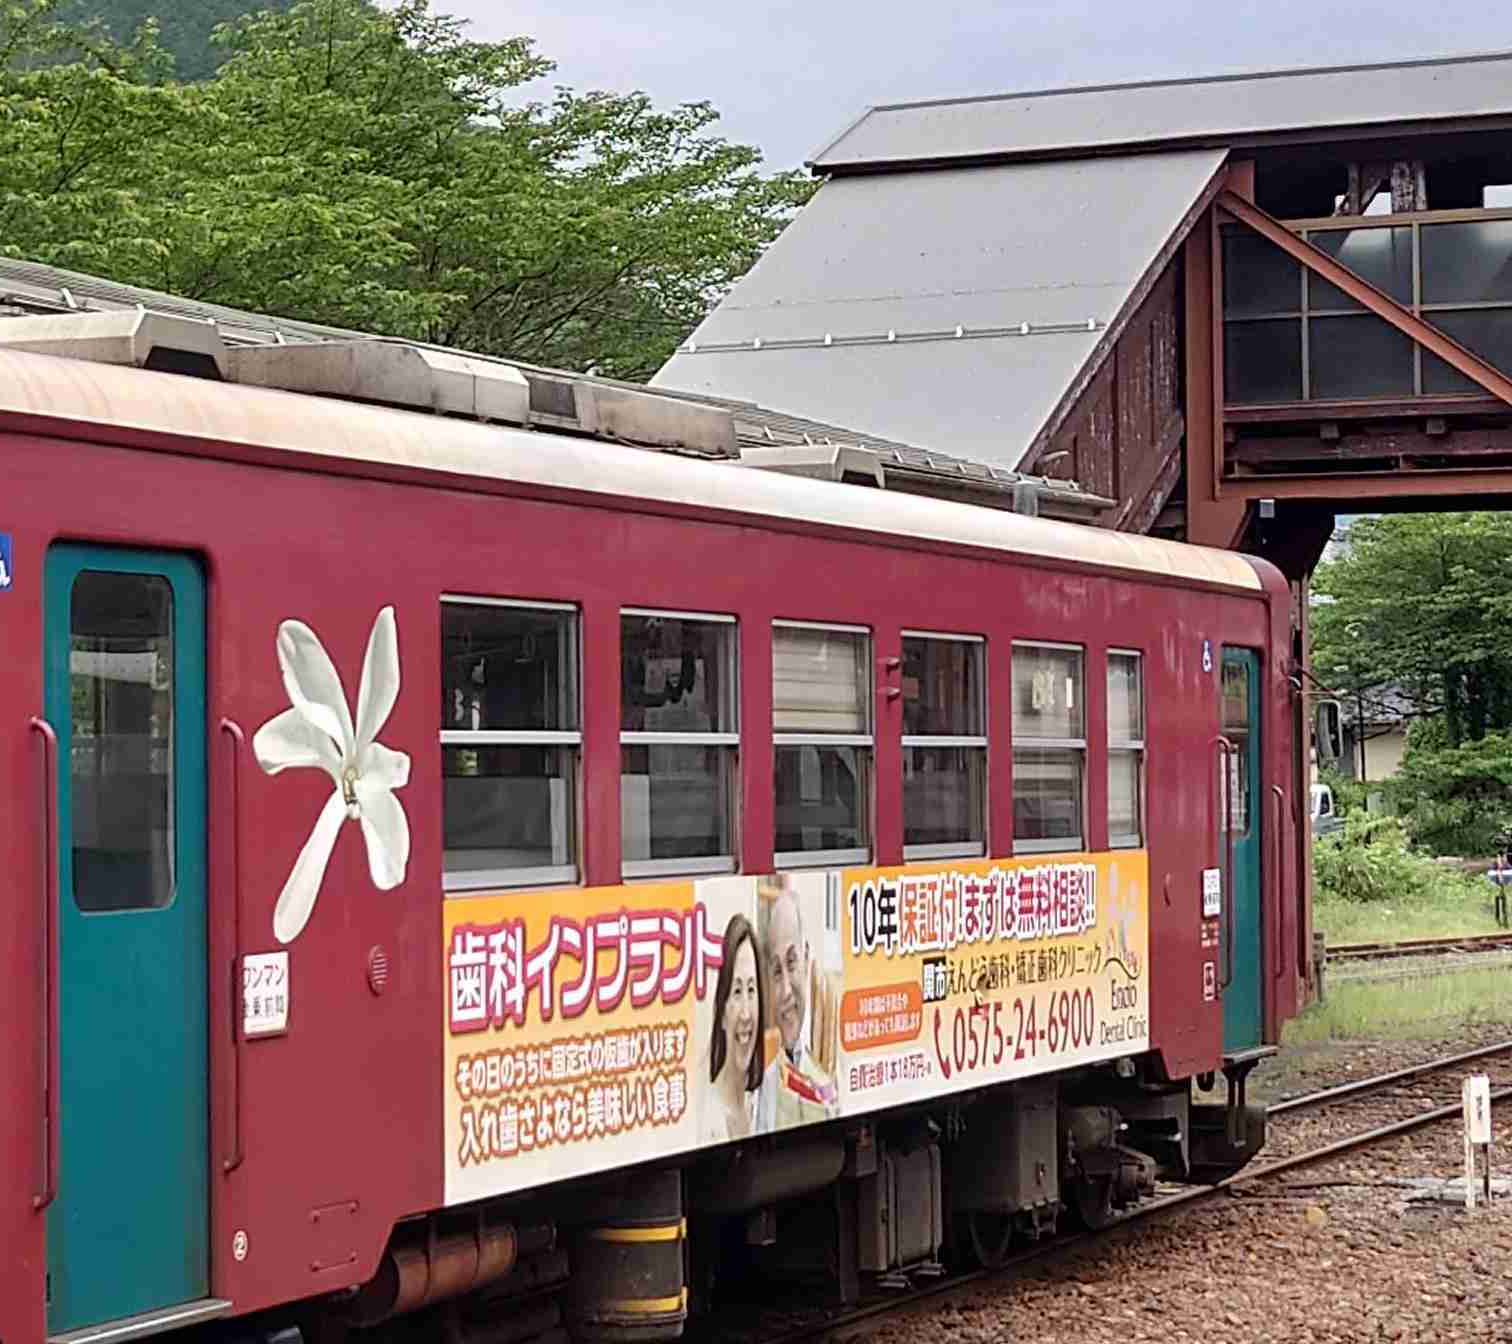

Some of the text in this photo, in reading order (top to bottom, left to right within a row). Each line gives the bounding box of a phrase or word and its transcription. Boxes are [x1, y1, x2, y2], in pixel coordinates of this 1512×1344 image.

[449, 904, 725, 1032] 歯科インプラント
[953, 987, 1095, 1073] 0575-24-6900
[1100, 1017, 1125, 1046] Dental
[460, 1070, 686, 1165] 入れ歯さよなら美味しい食事
